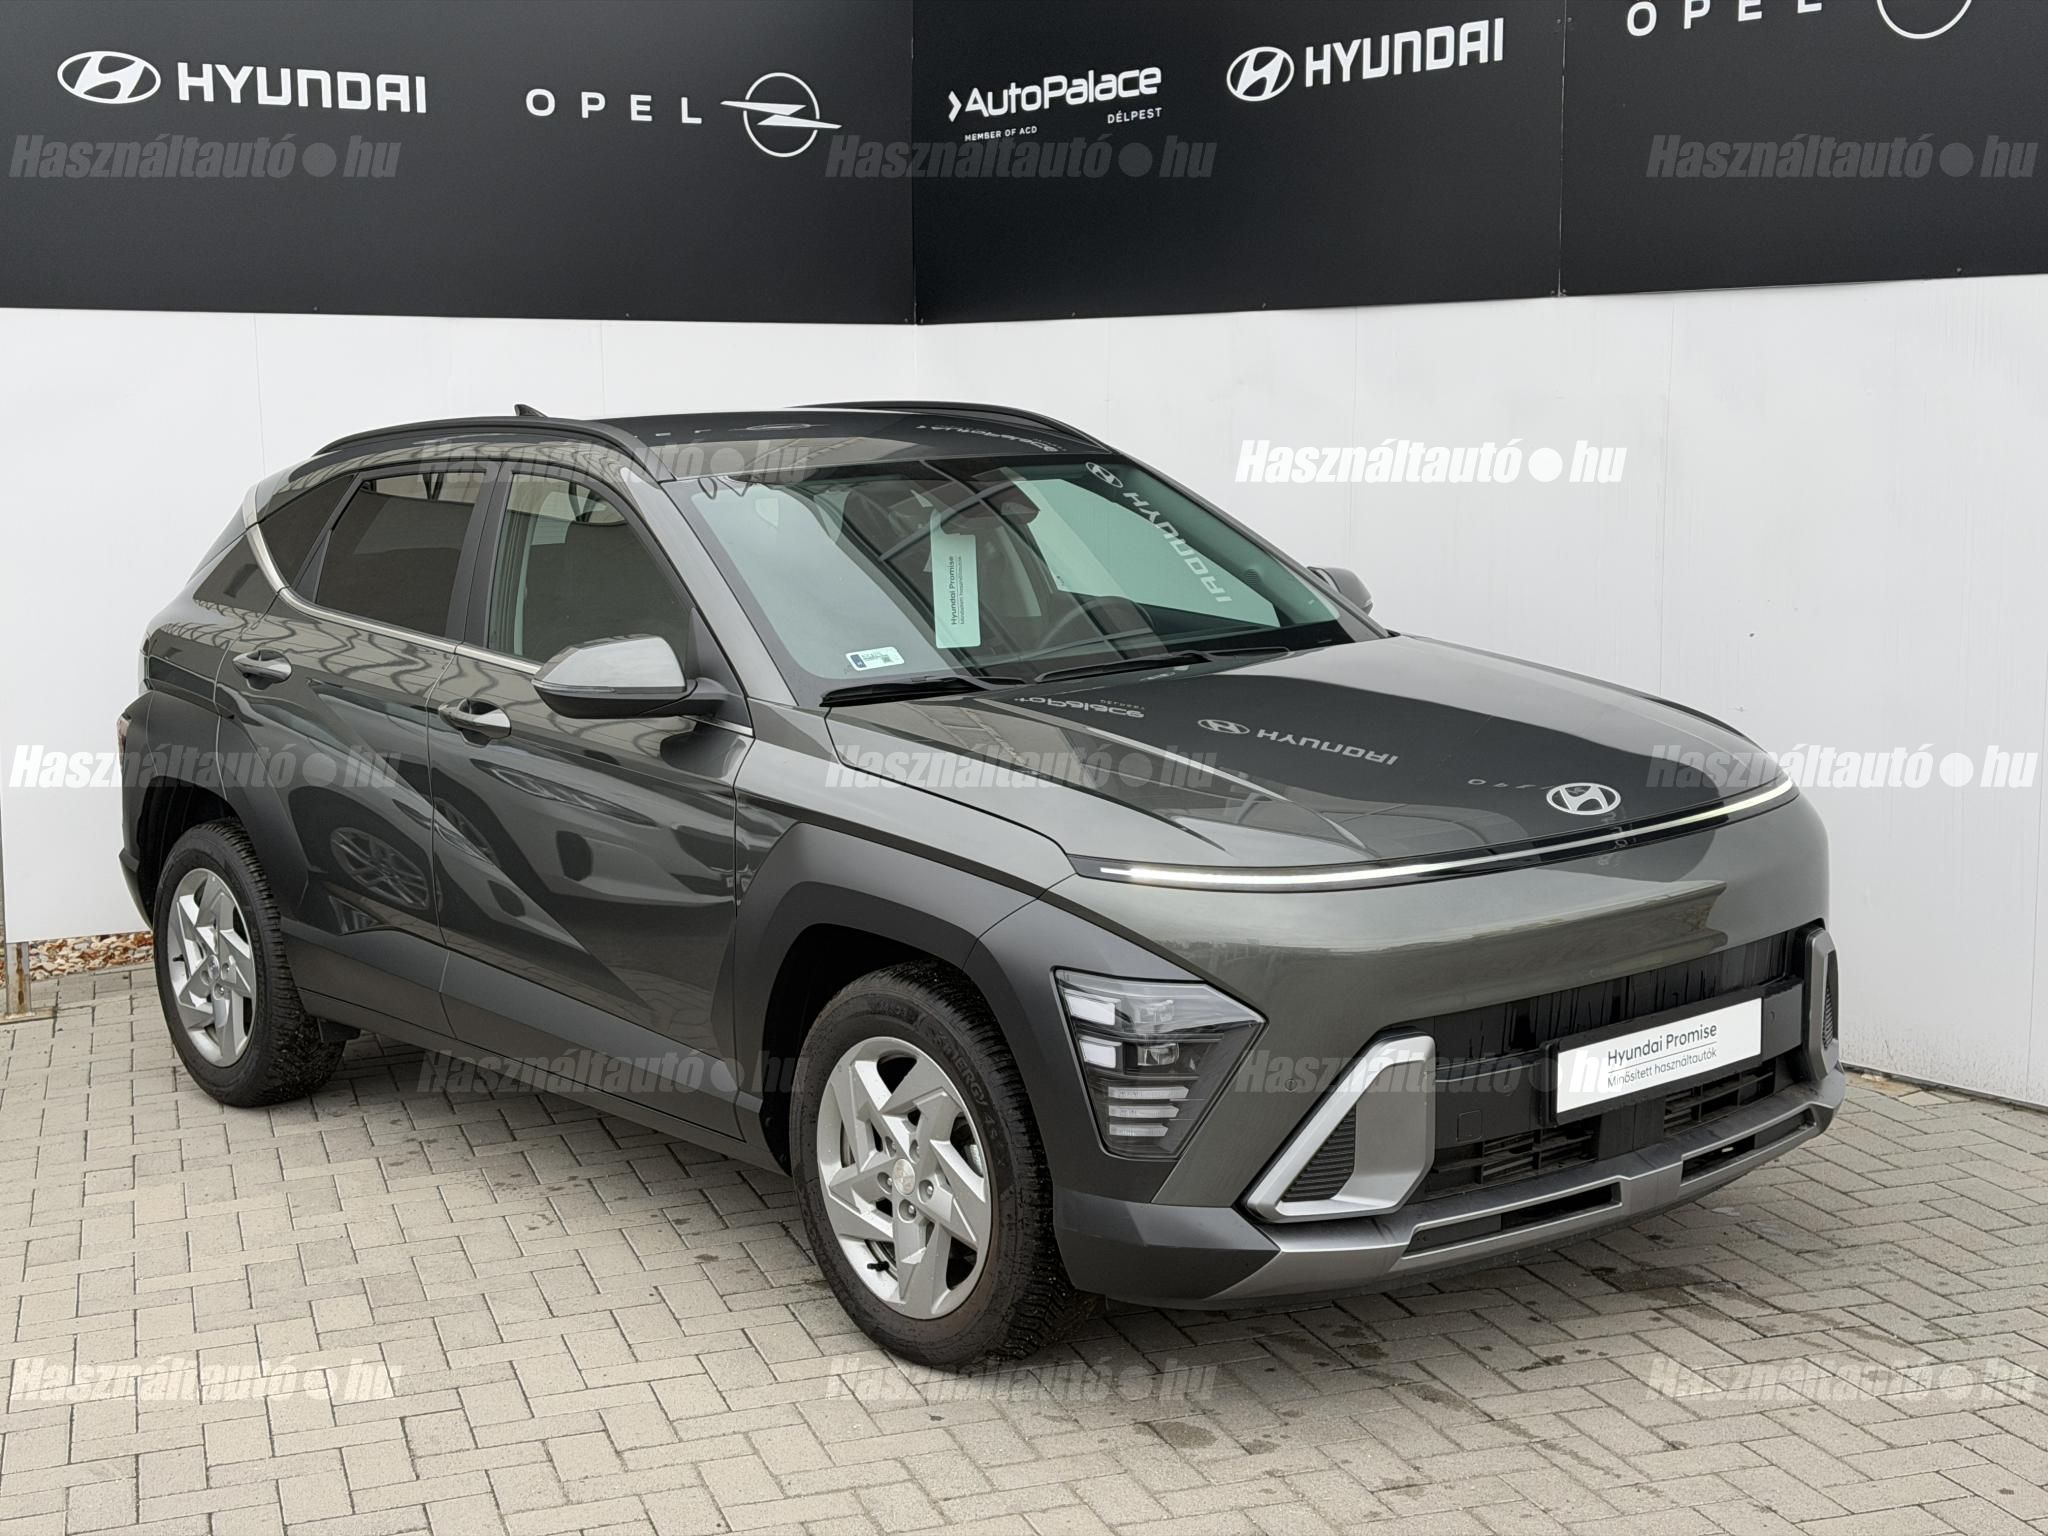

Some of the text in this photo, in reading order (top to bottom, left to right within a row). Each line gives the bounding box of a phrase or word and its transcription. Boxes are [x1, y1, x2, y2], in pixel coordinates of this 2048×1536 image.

[1304, 18, 1504, 87] HYUNDAI
[177, 62, 427, 113] HYUNDAI
[526, 87, 702, 125] OPEL
[965, 67, 1161, 117] AutoPalace
[964, 125, 1038, 142] MEMBER OF ACD
[1107, 107, 1163, 124] DÉLPEST
[1607, 1023, 1718, 1067] Hyundai Promise
[1654, 1046, 1718, 1075] használtautók
